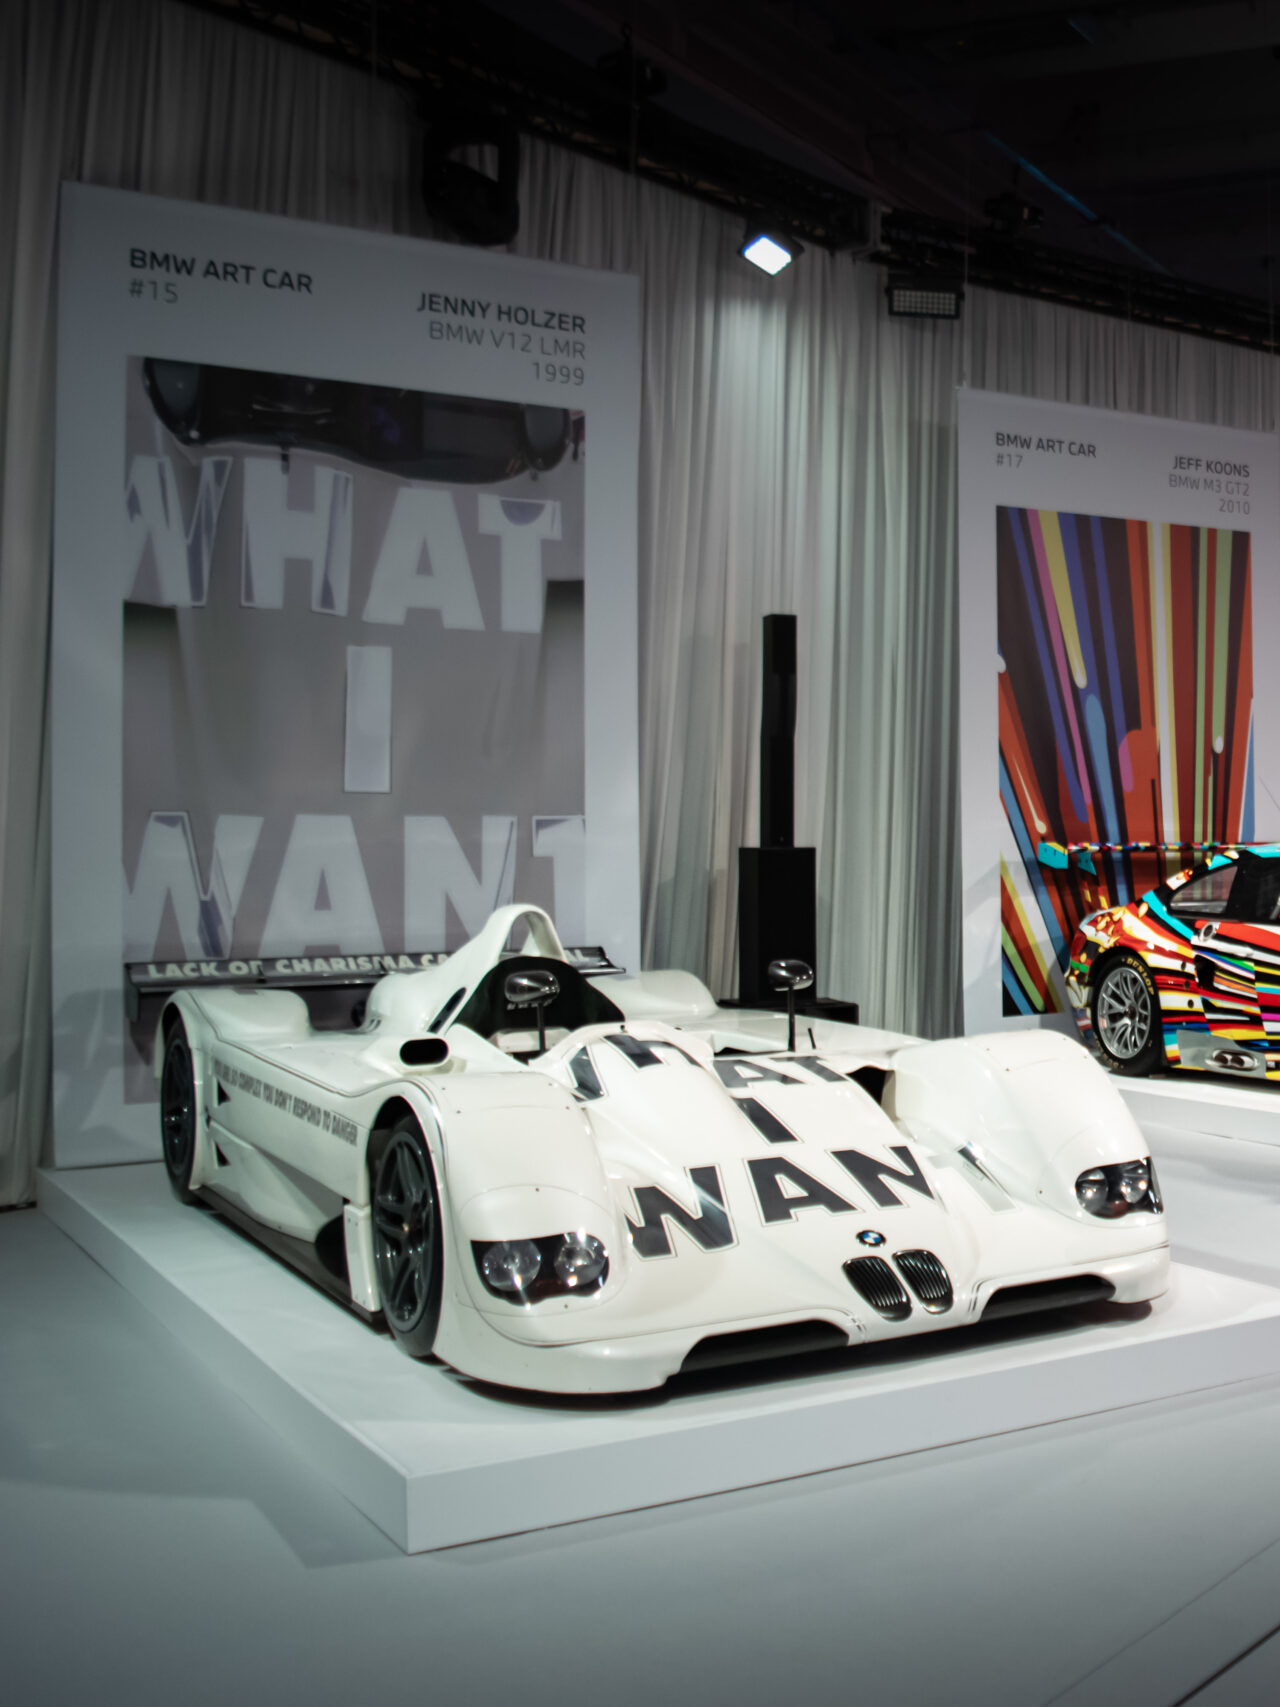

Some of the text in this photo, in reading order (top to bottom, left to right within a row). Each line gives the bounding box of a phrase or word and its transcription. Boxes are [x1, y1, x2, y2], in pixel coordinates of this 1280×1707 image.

[130, 249, 313, 294] BMW ART CAR
[129, 279, 178, 304] #15
[417, 292, 586, 334] JENNY HOLZER
[429, 321, 586, 360] BMW V12 LMR
[532, 362, 585, 386] 1999
[996, 432, 1097, 458] BMW ART CAR
[996, 454, 1023, 469] #17
[1172, 456, 1250, 478] JEFF KOONS
[1169, 474, 1250, 497] BMW M3 GT2
[1219, 499, 1251, 515] 2010
[124, 455, 562, 633] WHAT
[344, 646, 392, 793] I
[147, 962, 219, 978] LACK
[275, 954, 416, 974] CHARISMA
[1126, 957, 1154, 995] DUNLOP
